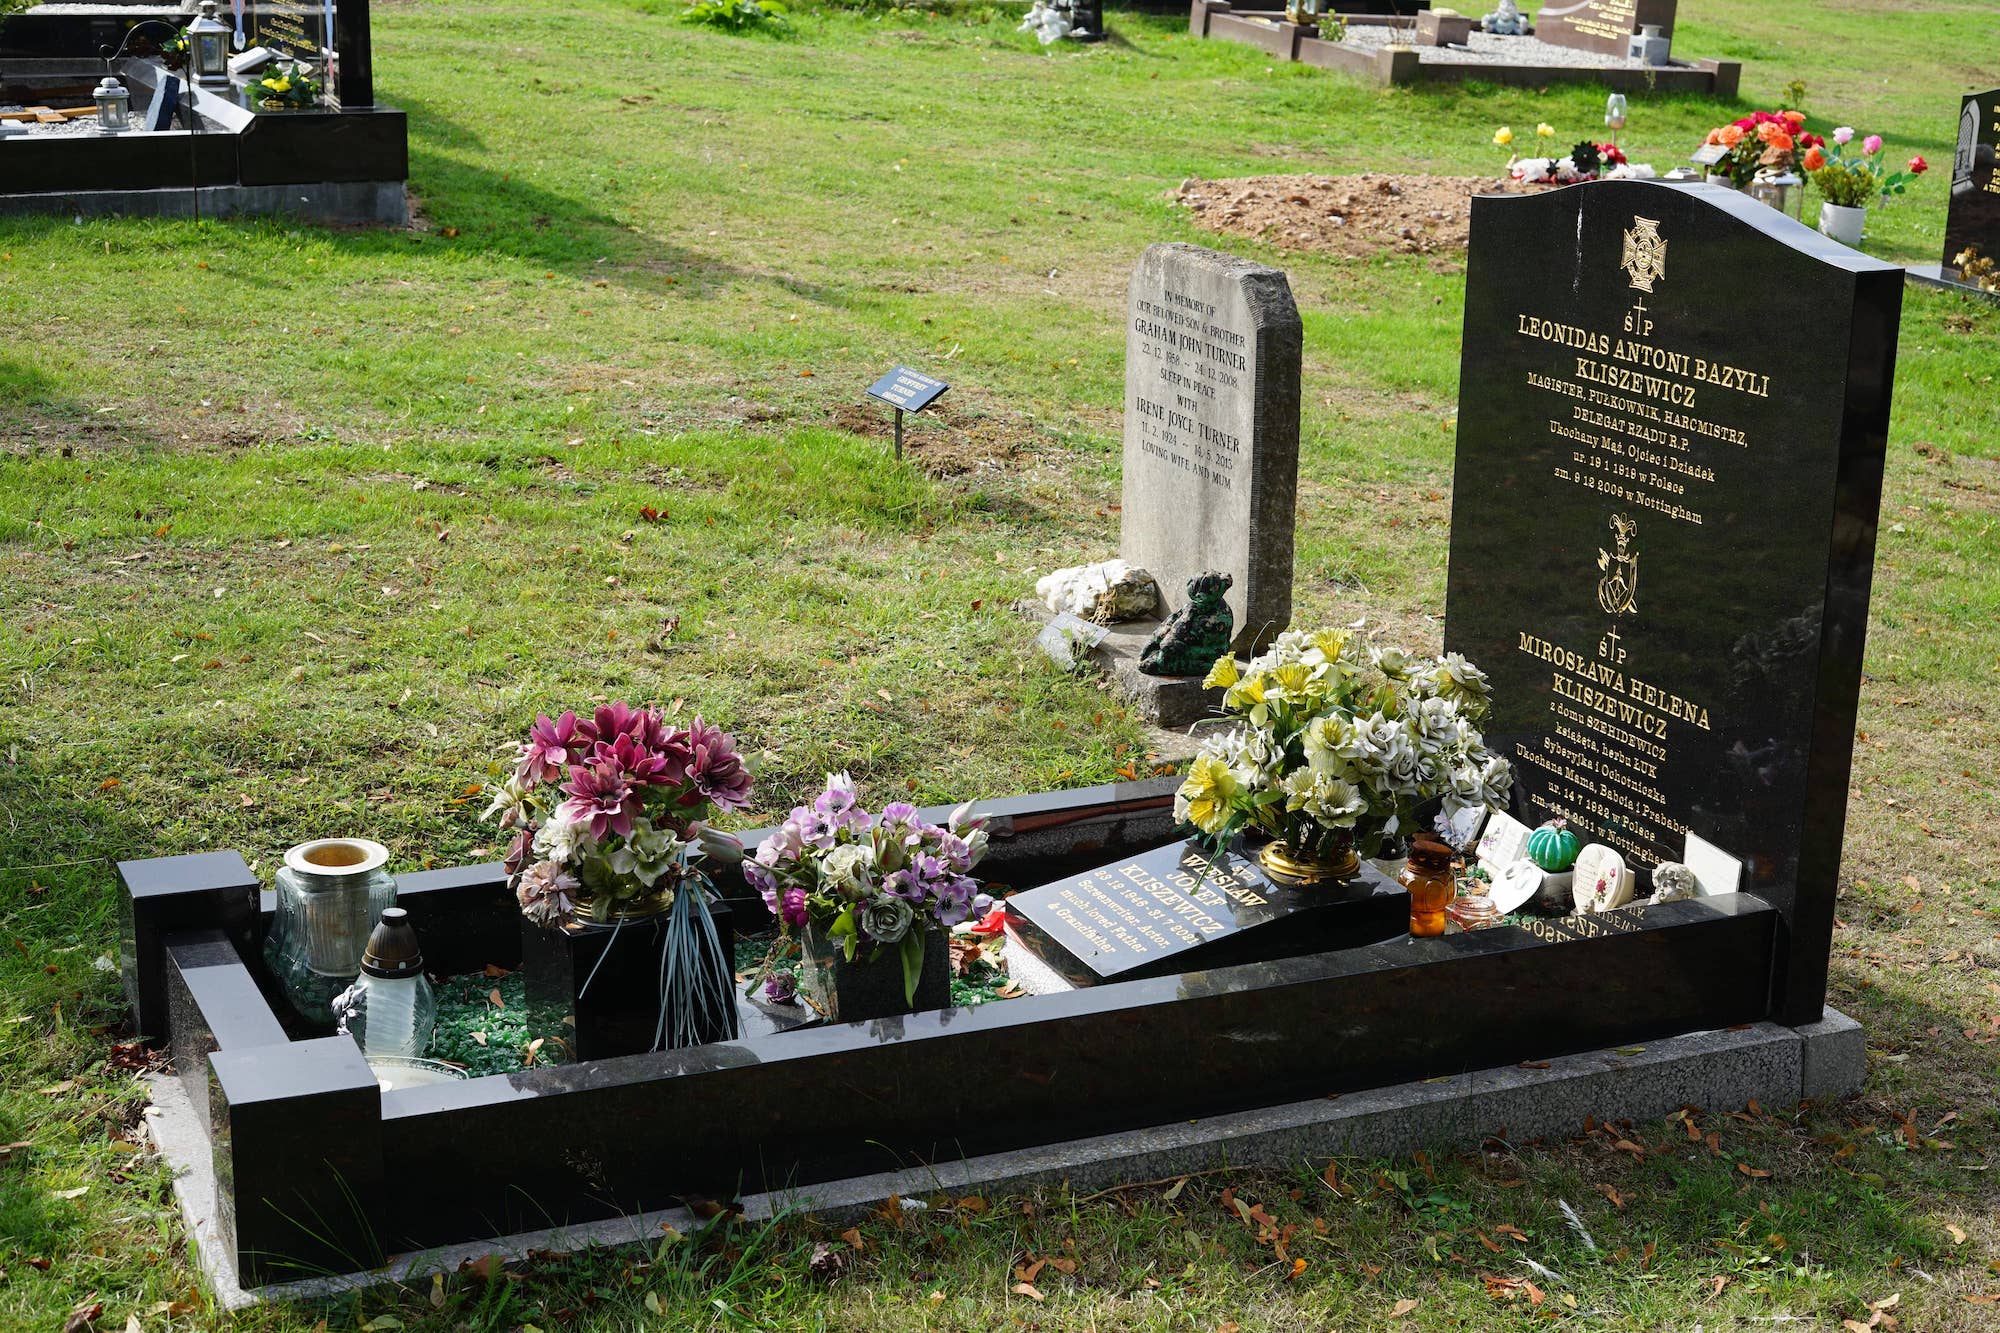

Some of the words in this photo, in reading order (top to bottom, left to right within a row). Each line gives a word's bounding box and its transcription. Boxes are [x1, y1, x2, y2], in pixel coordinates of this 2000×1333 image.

[1137, 300, 1151, 314] OUR
[1153, 305, 1184, 325] BELOVED
[1185, 317, 1200, 331] SON
[1210, 326, 1244, 347] BROTHER
[1165, 290, 1172, 302] IN
[1175, 294, 1203, 313] MEMORY
[1206, 304, 1216, 317] OF
[1644, 320, 1653, 336] P
[1135, 318, 1176, 345] GRAHAM
[1179, 334, 1202, 354] JOHN
[1205, 343, 1245, 371] TURNER
[1519, 315, 1609, 354] LEONIDAS
[1614, 340, 1689, 376] ANTONI
[1694, 359, 1769, 397] BAZYLI
[1161, 368, 1181, 385] SLEEP
[1183, 377, 1191, 389] IN
[1177, 394, 1197, 412] WITH
[1577, 358, 1694, 407] KLISZEWICZ
[1137, 397, 1164, 420] IRENE
[1168, 410, 1193, 433] JOYCE
[1198, 423, 1239, 453] TURNER
[1528, 372, 1586, 400] MAGISTER,
[1589, 389, 1660, 422] PUŁKOWNIK,
[1664, 411, 1747, 447] HARCMISTRZ,
[1574, 406, 1625, 432] DELEGAT
[1627, 422, 1667, 444] RZĄDU
[1669, 434, 1690, 452] R.P.
[1162, 430, 1176, 446] 1924
[1550, 420, 1599, 448] Ukochany
[1601, 436, 1625, 456] Mąż,
[1628, 445, 1660, 465] Ojciec
[1662, 455, 1667, 467] i
[1670, 457, 1714, 482] Dziadek
[1142, 440, 1168, 460] LOVING
[1171, 452, 1189, 470] WIFE
[1193, 464, 1210, 479] AND
[1212, 472, 1230, 489] MUM
[1573, 452, 1586, 463] ur.
[1590, 456, 1601, 468] 19
[1604, 460, 1609, 471] 1
[1613, 464, 1636, 479] 1919
[1639, 472, 1646, 483] w
[1649, 473, 1684, 494] Polsce
[1554, 468, 1571, 480] zm.
[1574, 472, 1580, 483] 9
[1583, 476, 1594, 488] 12
[1597, 480, 1623, 497] 2009
[1625, 490, 1634, 501] w
[1636, 491, 1702, 524] Nottingham
[1520, 632, 1624, 692] MIROSŁAWA
[1630, 679, 1710, 730] HELENA
[1617, 648, 1627, 665] P
[1553, 673, 1666, 739] KLISZEWICZ
[1550, 702, 1555, 711] z
[1557, 703, 1584, 724] domu
[1587, 716, 1665, 760] SZEHIDEWICZ
[1516, 743, 1562, 775] Ukochana
[1565, 766, 1597, 793] Mama,
[1600, 784, 1634, 810] Babcia
[1636, 802, 1640, 813] i
[1544, 737, 1592, 769] Syberyjka
[1595, 761, 1599, 772] i
[1602, 764, 1665, 804] Ochotniczka
[1602, 743, 1631, 767] herbu
[1633, 757, 1657, 778] ŁUK
[1531, 794, 1548, 808] zm.
[1572, 812, 1594, 832] 2011
[1597, 826, 1606, 837] w
[1548, 782, 1561, 795] ur.
[1564, 788, 1574, 801] 14
[1577, 794, 1583, 805] 7
[1612, 813, 1620, 824] w
[1622, 816, 1655, 841] Polsce
[1059, 888, 1089, 910] much
[1088, 907, 1114, 928] loved
[1112, 926, 1148, 954] Father
[1118, 864, 1225, 935] KLISZEWICZ
[1162, 918, 1170, 926] 7
[1056, 908, 1116, 955] Grandfather
[1137, 925, 1171, 949] Actor,
